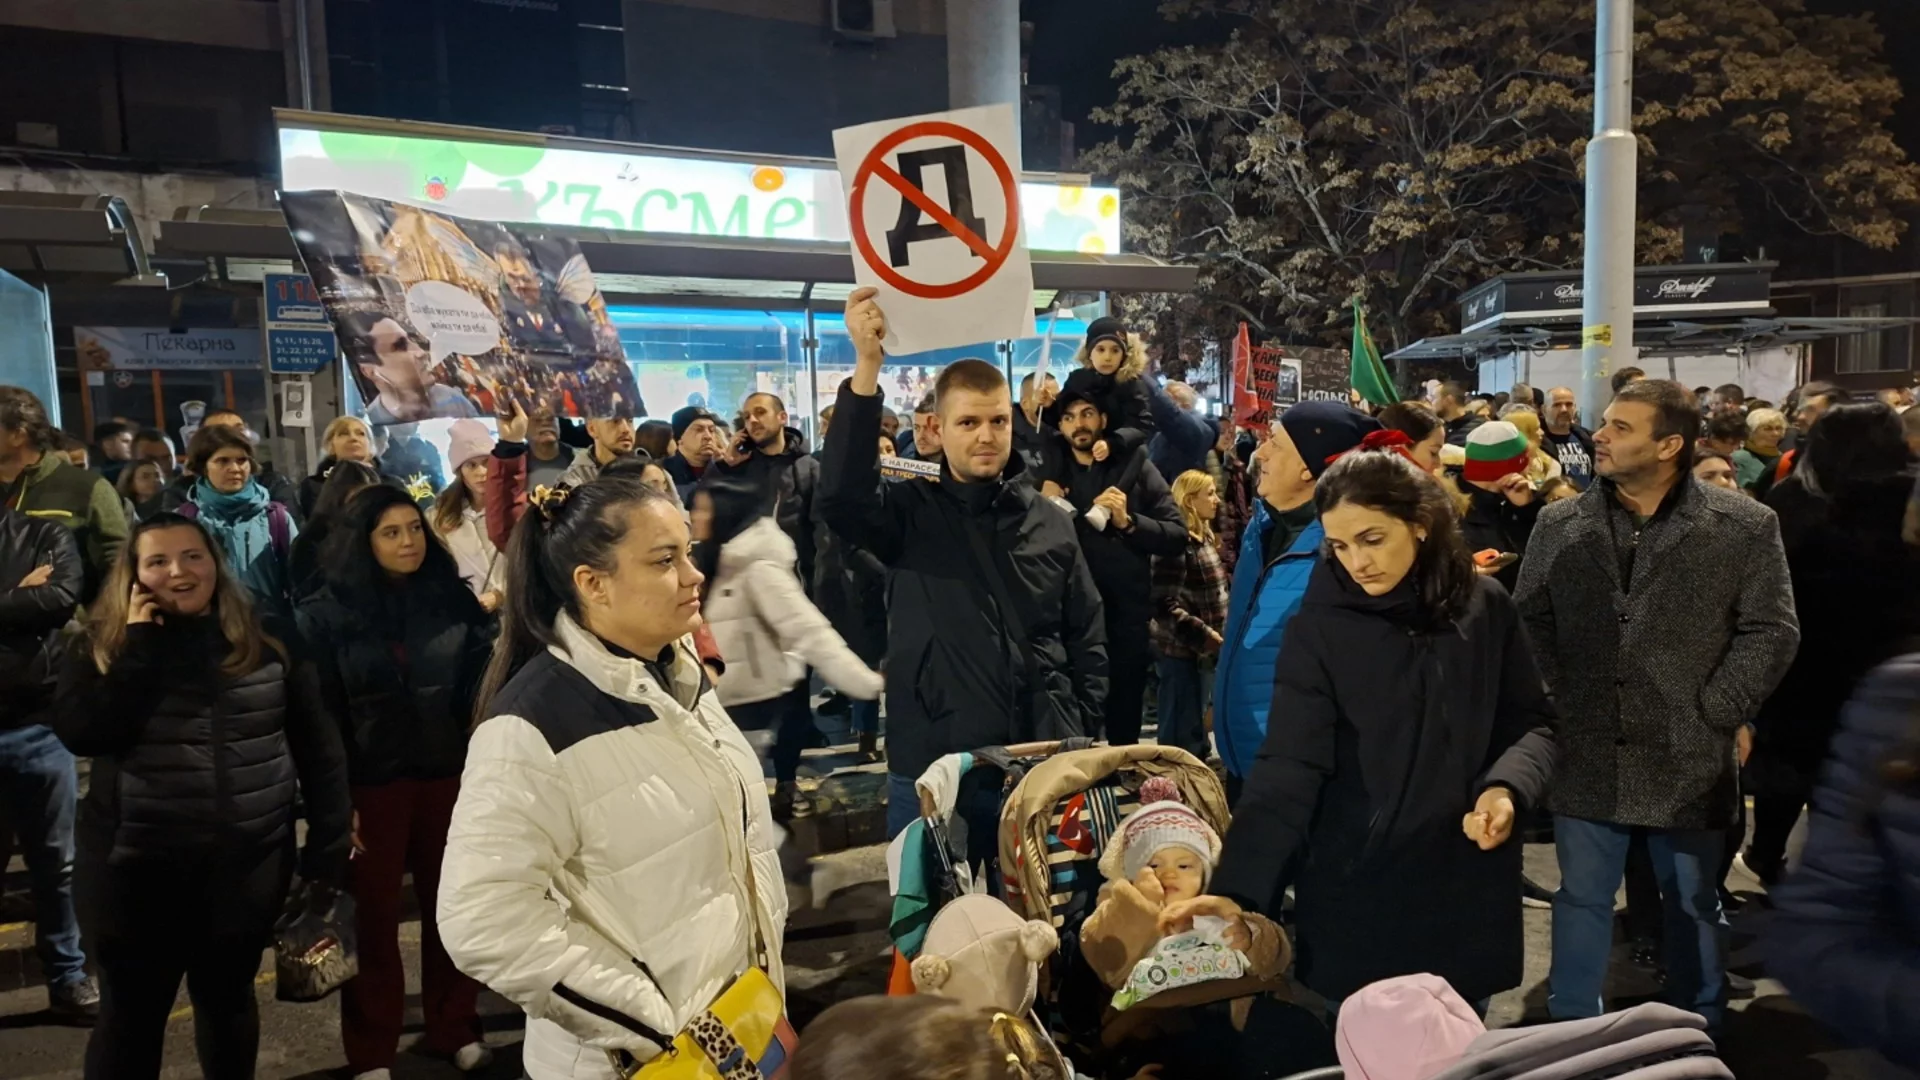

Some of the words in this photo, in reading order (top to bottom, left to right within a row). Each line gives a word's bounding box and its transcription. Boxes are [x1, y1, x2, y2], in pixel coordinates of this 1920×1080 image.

[885, 145, 988, 268] Д
[1653, 276, 1716, 299] Davidoff
[141, 332, 236, 355] Пекарна
[1556, 442, 1583, 455] NYC
[889, 459, 901, 467] НА
